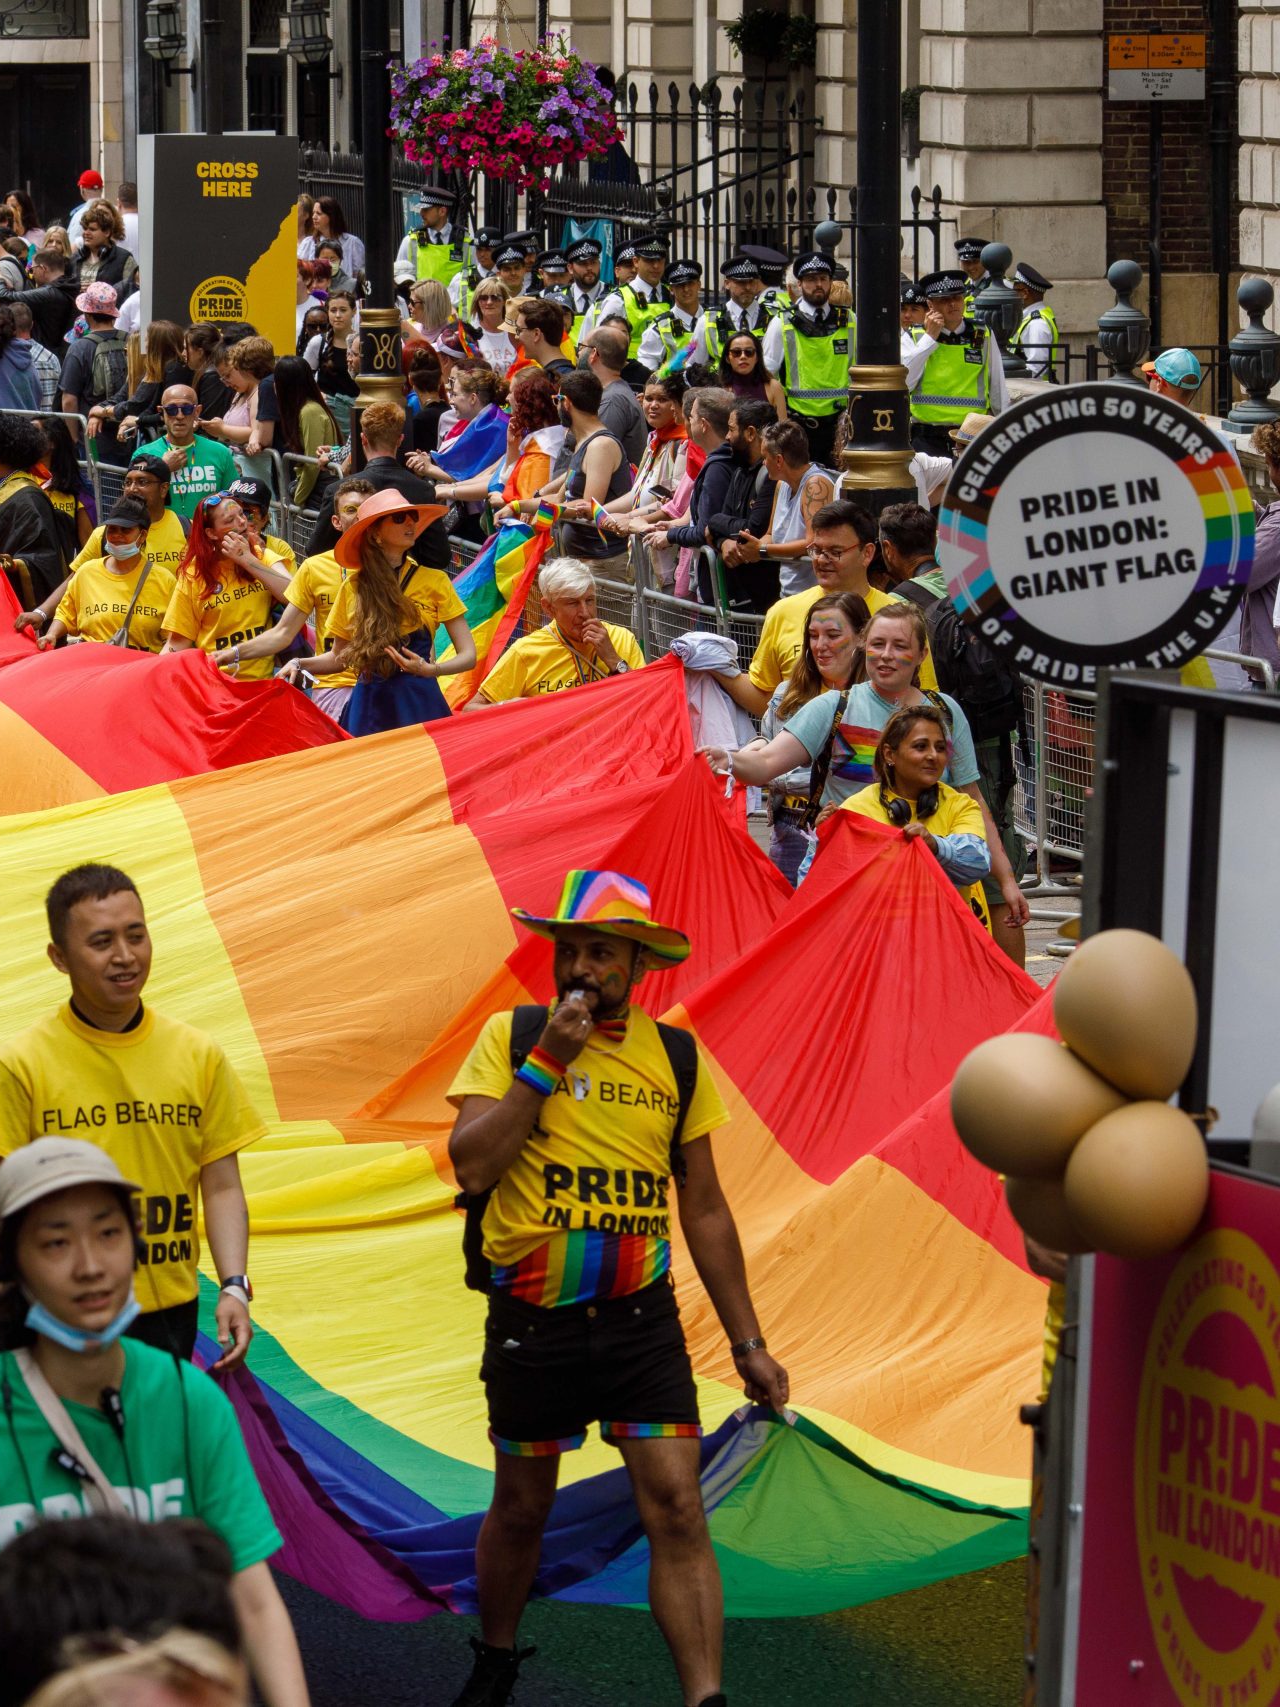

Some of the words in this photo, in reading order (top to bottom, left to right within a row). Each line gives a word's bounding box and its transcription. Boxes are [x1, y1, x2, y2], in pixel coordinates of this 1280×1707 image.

[196, 162, 259, 178] CROSS
[202, 181, 252, 197] HERE
[198, 310, 207, 318] IN
[209, 310, 243, 318] LONDON
[957, 397, 1097, 502] CELEBRATING
[1103, 398, 1137, 419] 50
[1143, 401, 1214, 466] YEARS
[169, 465, 217, 483] R!DE
[172, 482, 217, 494] LONDON
[1019, 483, 1118, 523] PRIDE
[1126, 476, 1161, 506] IN
[1024, 515, 1169, 560] LONDON:
[147, 551, 186, 563] BEARE
[1010, 561, 1108, 600] GIANT
[1115, 547, 1198, 583] FLAG
[85, 603, 108, 616] FLAG
[320, 594, 334, 605] FL
[980, 617, 1013, 648] OF
[1014, 645, 1097, 683] PRIDE
[1145, 629, 1198, 670] THE
[1194, 577, 1236, 631] U.K.
[600, 1080, 680, 1118] BEARE
[42, 1104, 106, 1133] FLAG
[115, 1101, 202, 1128] BEARER
[543, 1206, 572, 1228] IN
[582, 1209, 669, 1236] LONDON
[136, 1239, 191, 1266] NDON
[1156, 1481, 1179, 1538] IN
[1185, 1490, 1280, 1579] LONDON
[1160, 1612, 1202, 1697] PRIDE
